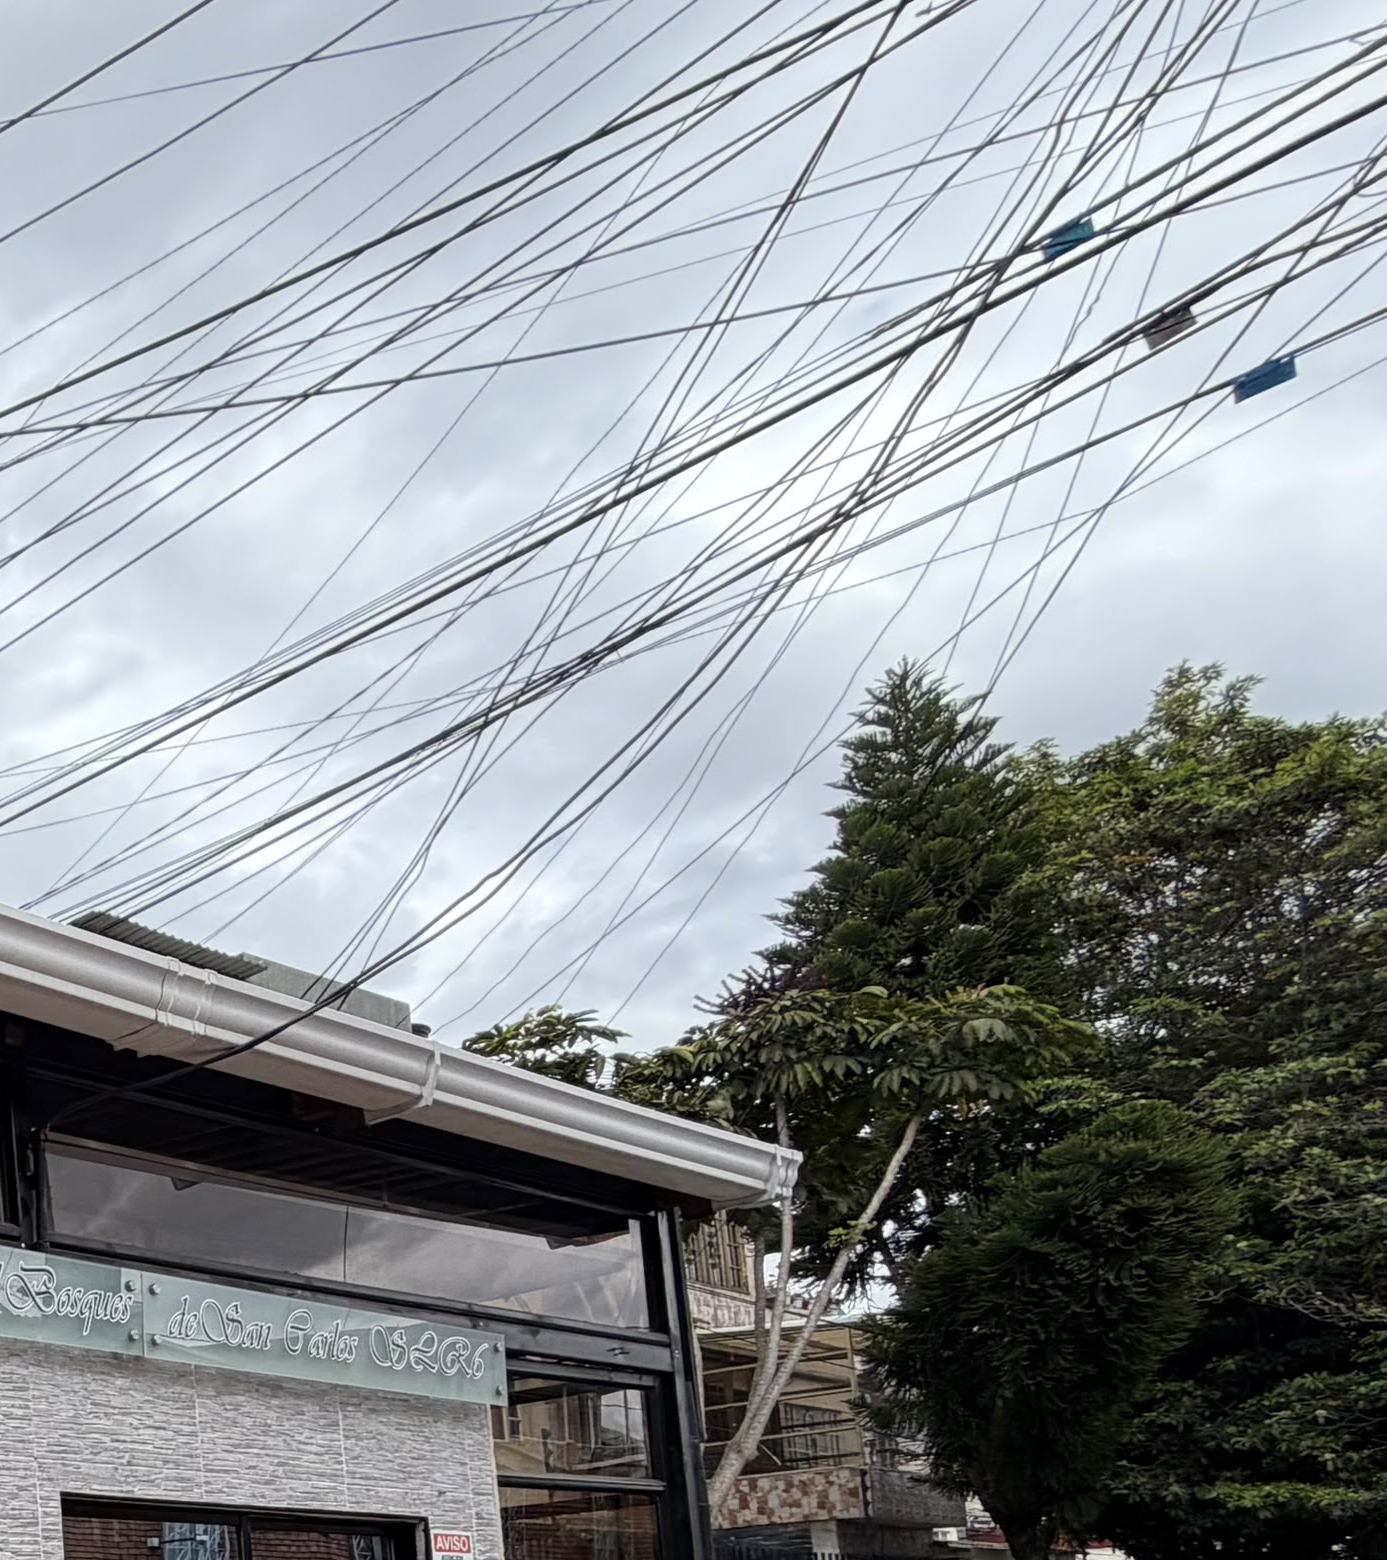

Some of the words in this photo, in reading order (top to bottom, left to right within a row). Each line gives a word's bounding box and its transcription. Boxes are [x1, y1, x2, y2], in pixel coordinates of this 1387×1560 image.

[4, 1261, 135, 1336] Bosques
[168, 1294, 200, 1341] de
[199, 1298, 273, 1351] San
[283, 1308, 359, 1363] Carlos
[436, 1535, 469, 1552] AVISO
